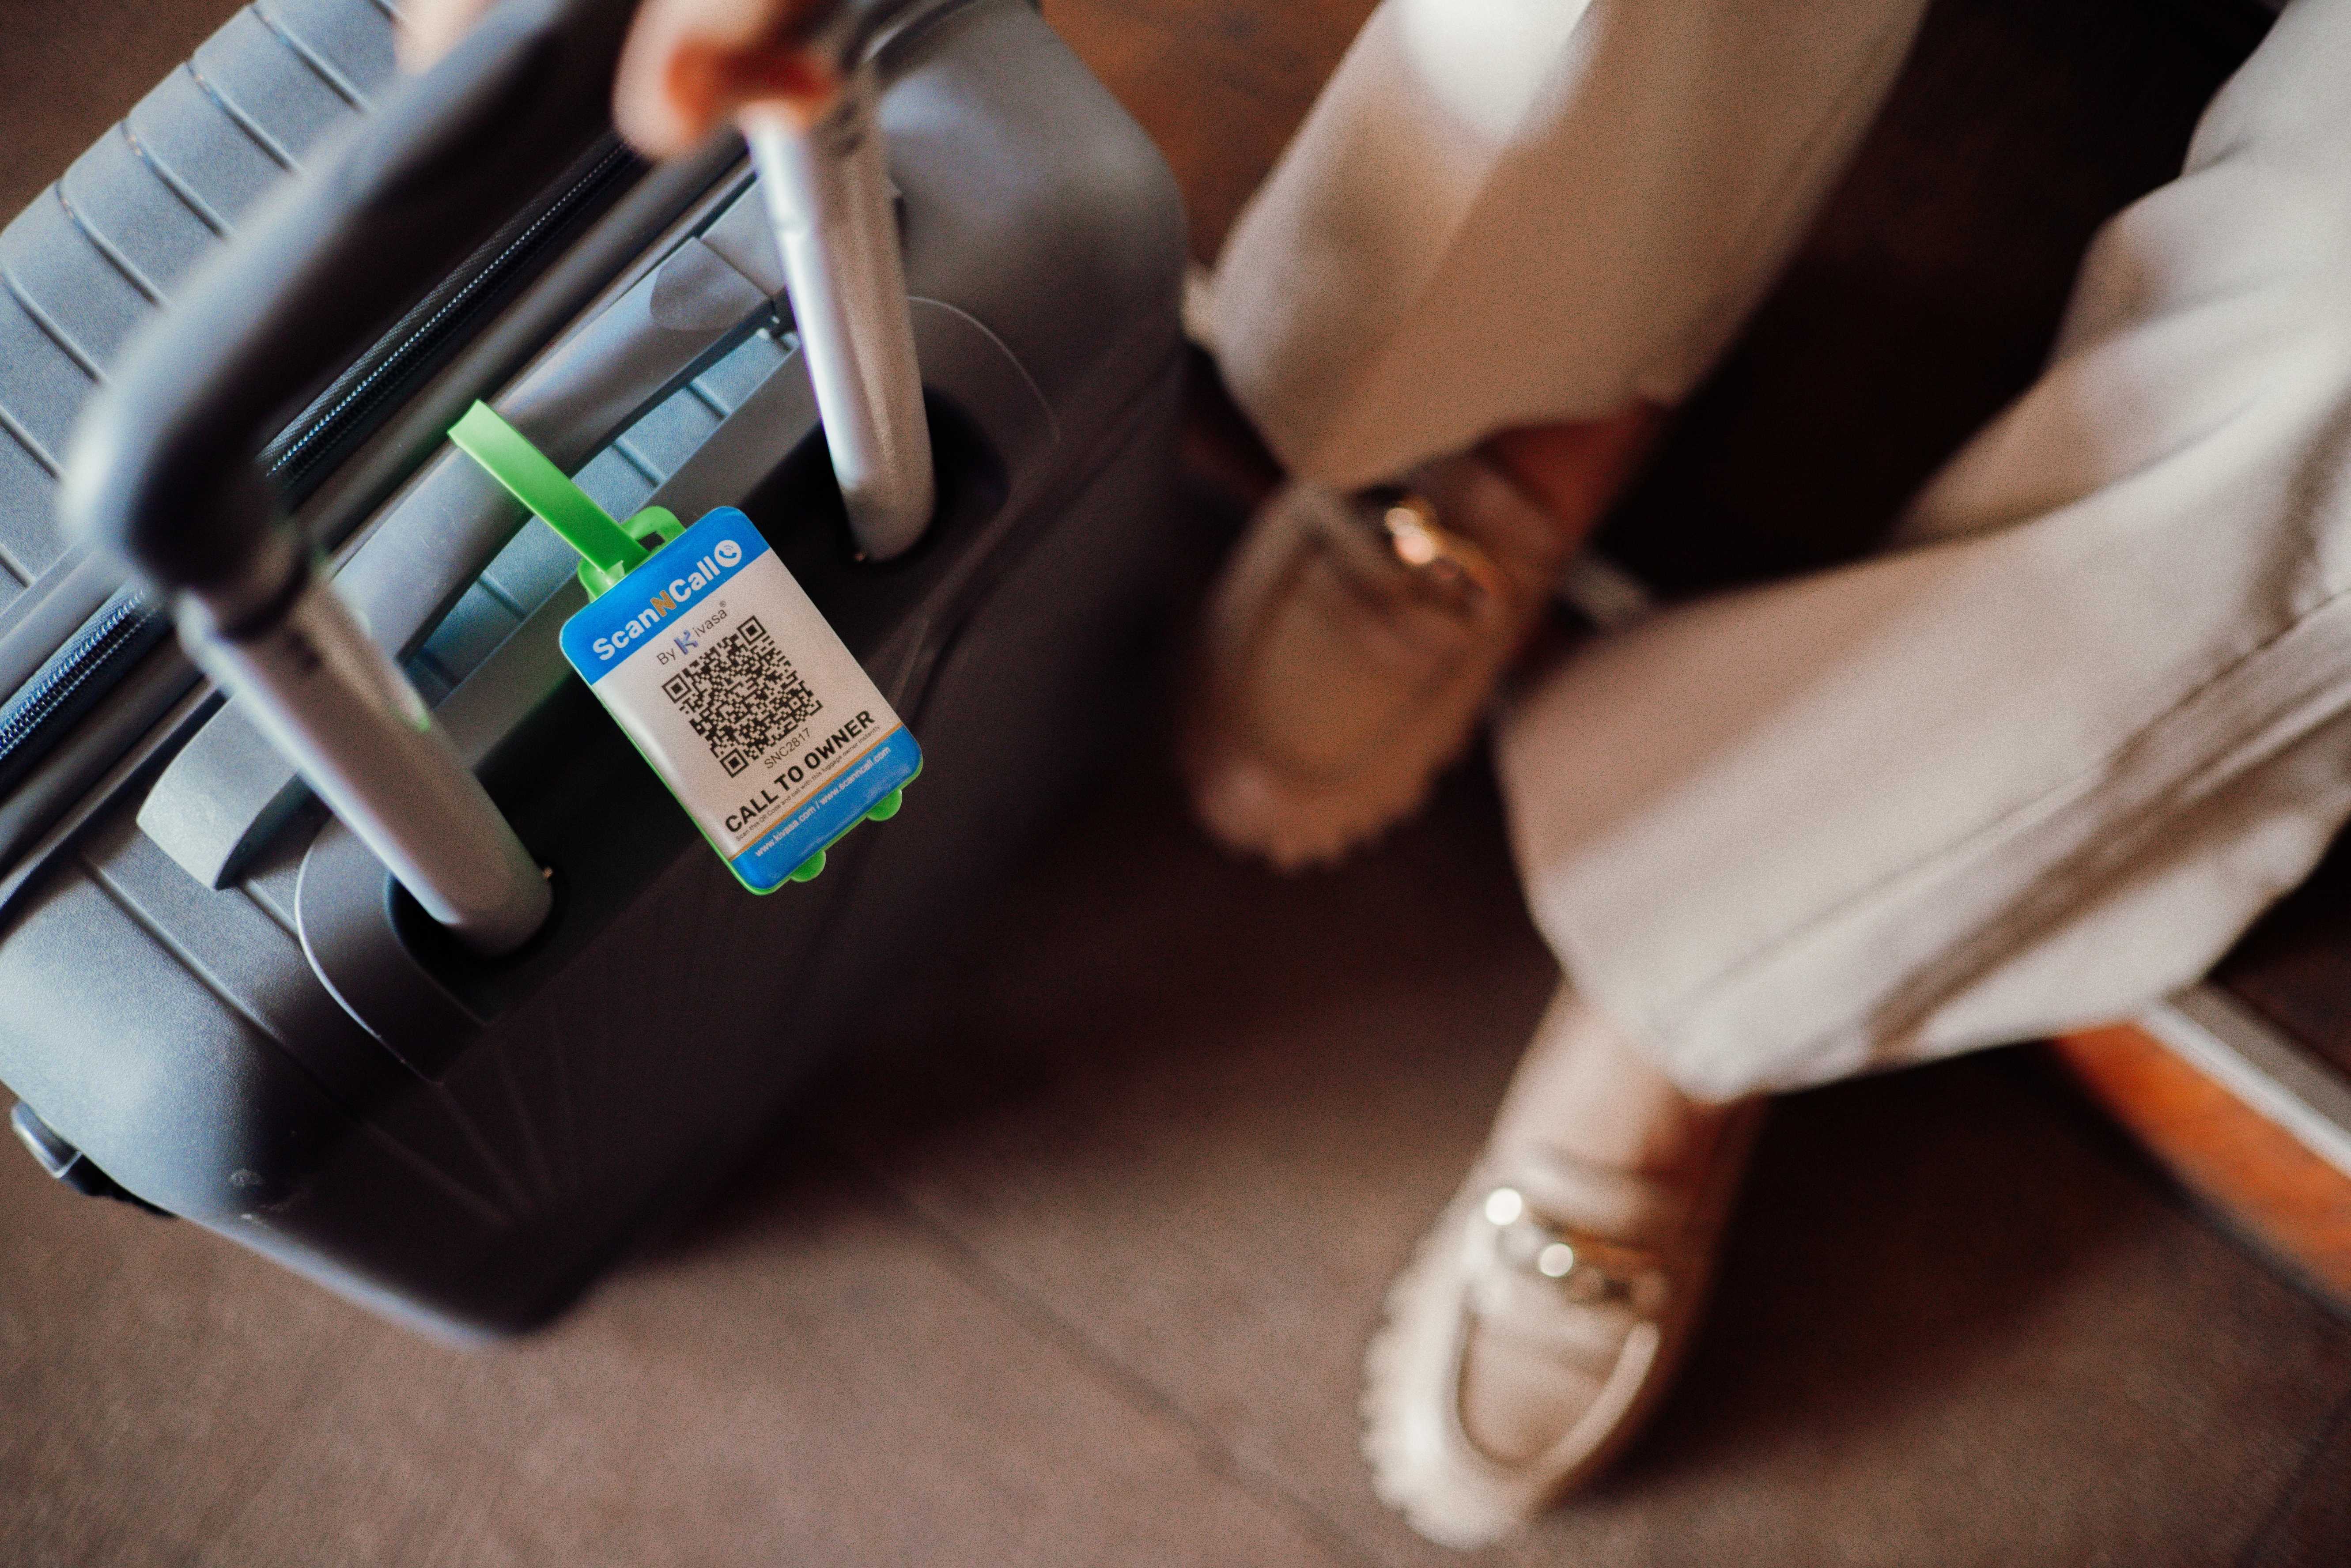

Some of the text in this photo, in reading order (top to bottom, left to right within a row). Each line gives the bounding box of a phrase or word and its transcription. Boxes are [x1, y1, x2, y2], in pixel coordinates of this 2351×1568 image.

[593, 555, 720, 661] ScanNCall
[657, 648, 677, 665] By
[725, 710, 875, 832] CALL TO OWNER
[736, 830, 749, 841] Scan
[749, 822, 760, 830] this
[767, 804, 781, 816] Code
[781, 796, 791, 805] and
[791, 787, 801, 797] call
[801, 779, 812, 789] with
[812, 771, 822, 780] this
[822, 756, 842, 772] luggage
[843, 743, 858, 757] owner
[858, 725, 880, 744] instantly
[756, 746, 891, 857] www.kivasa.com / www.scanncall.com
[764, 728, 810, 768] SNC2817
